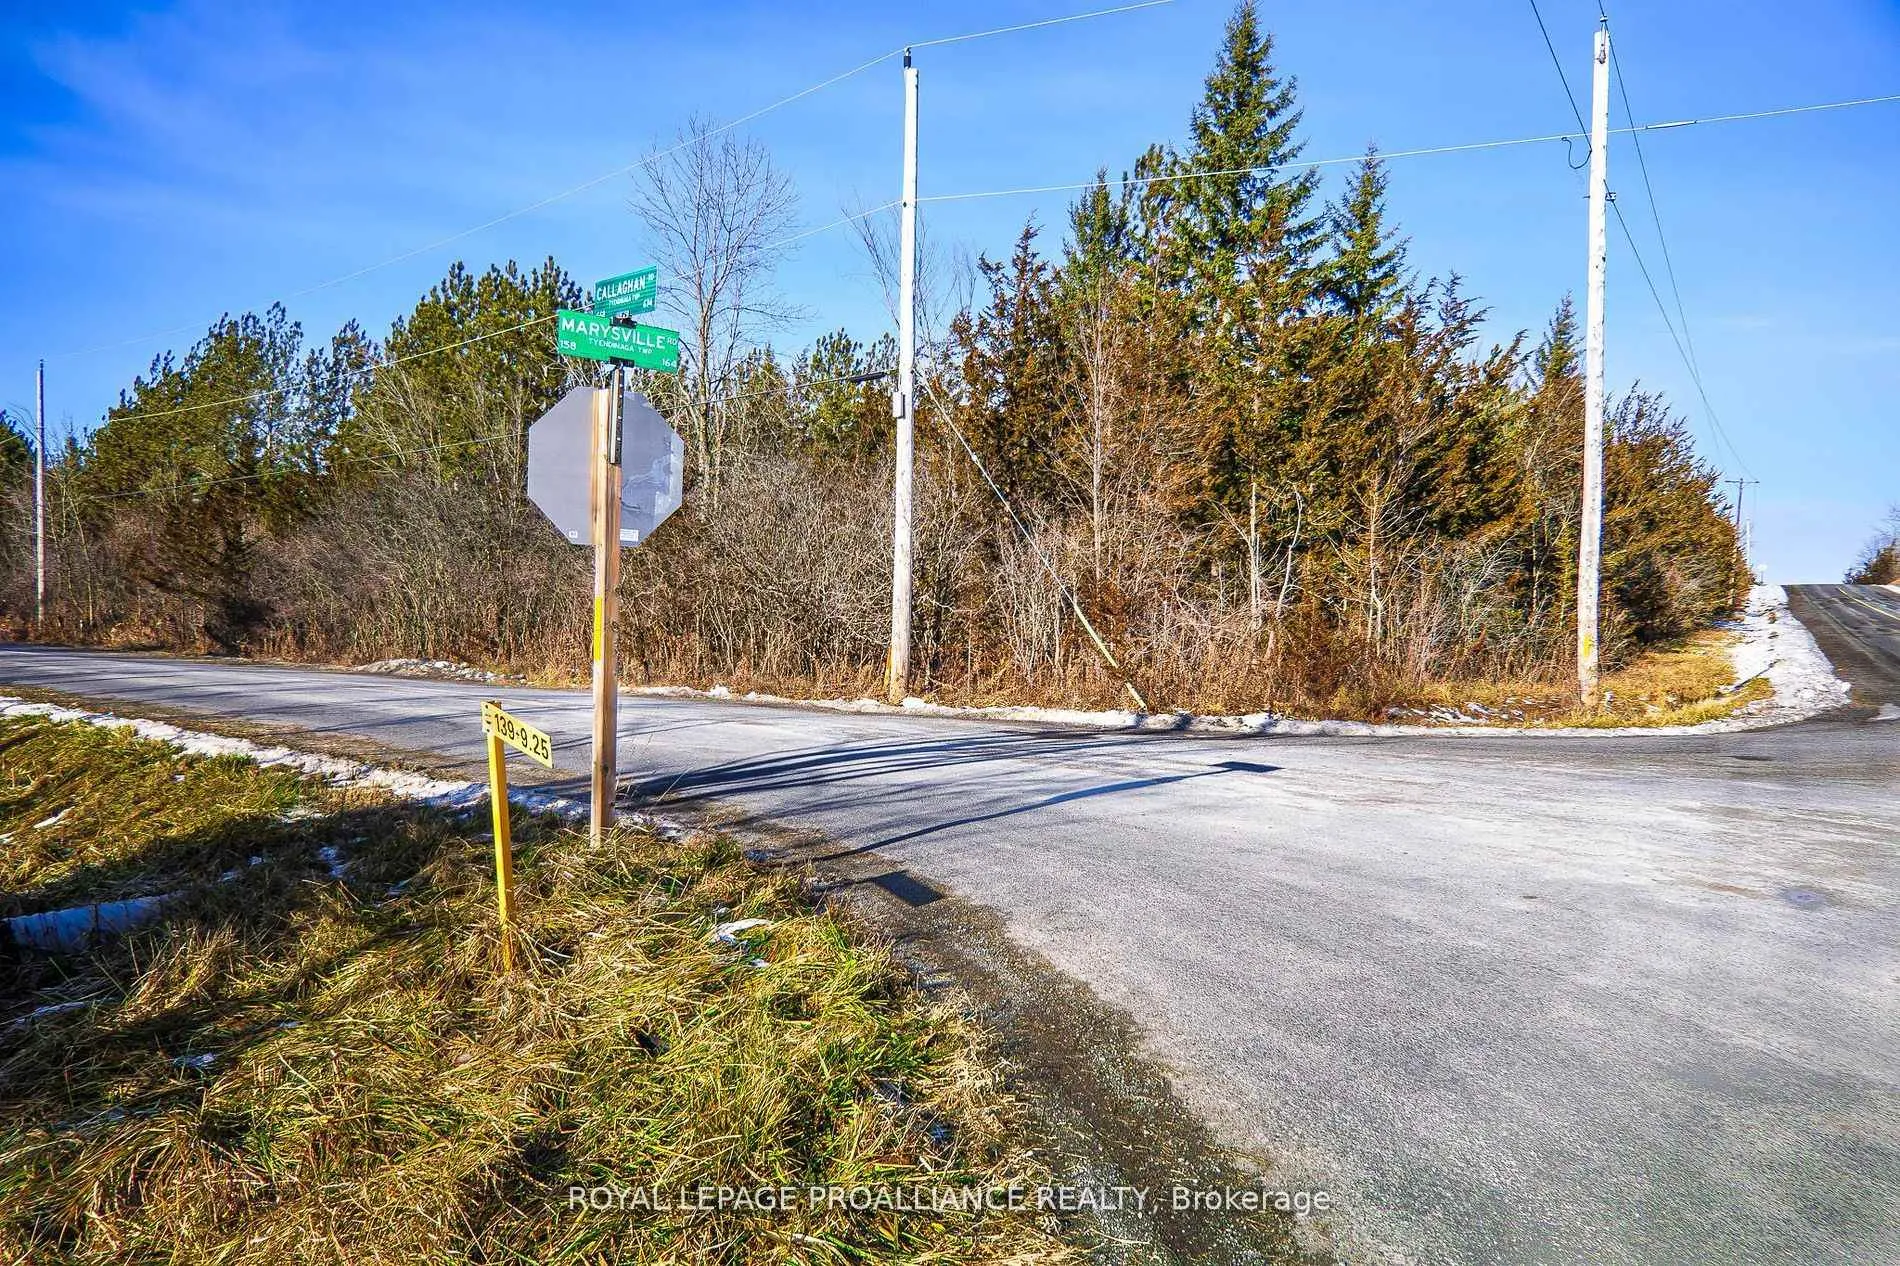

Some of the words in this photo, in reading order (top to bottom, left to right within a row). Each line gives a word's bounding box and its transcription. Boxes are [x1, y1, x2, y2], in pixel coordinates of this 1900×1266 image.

[597, 275, 646, 301] CALLAGHAN
[559, 339, 577, 351] 158
[561, 317, 666, 350] MARYSVILLE
